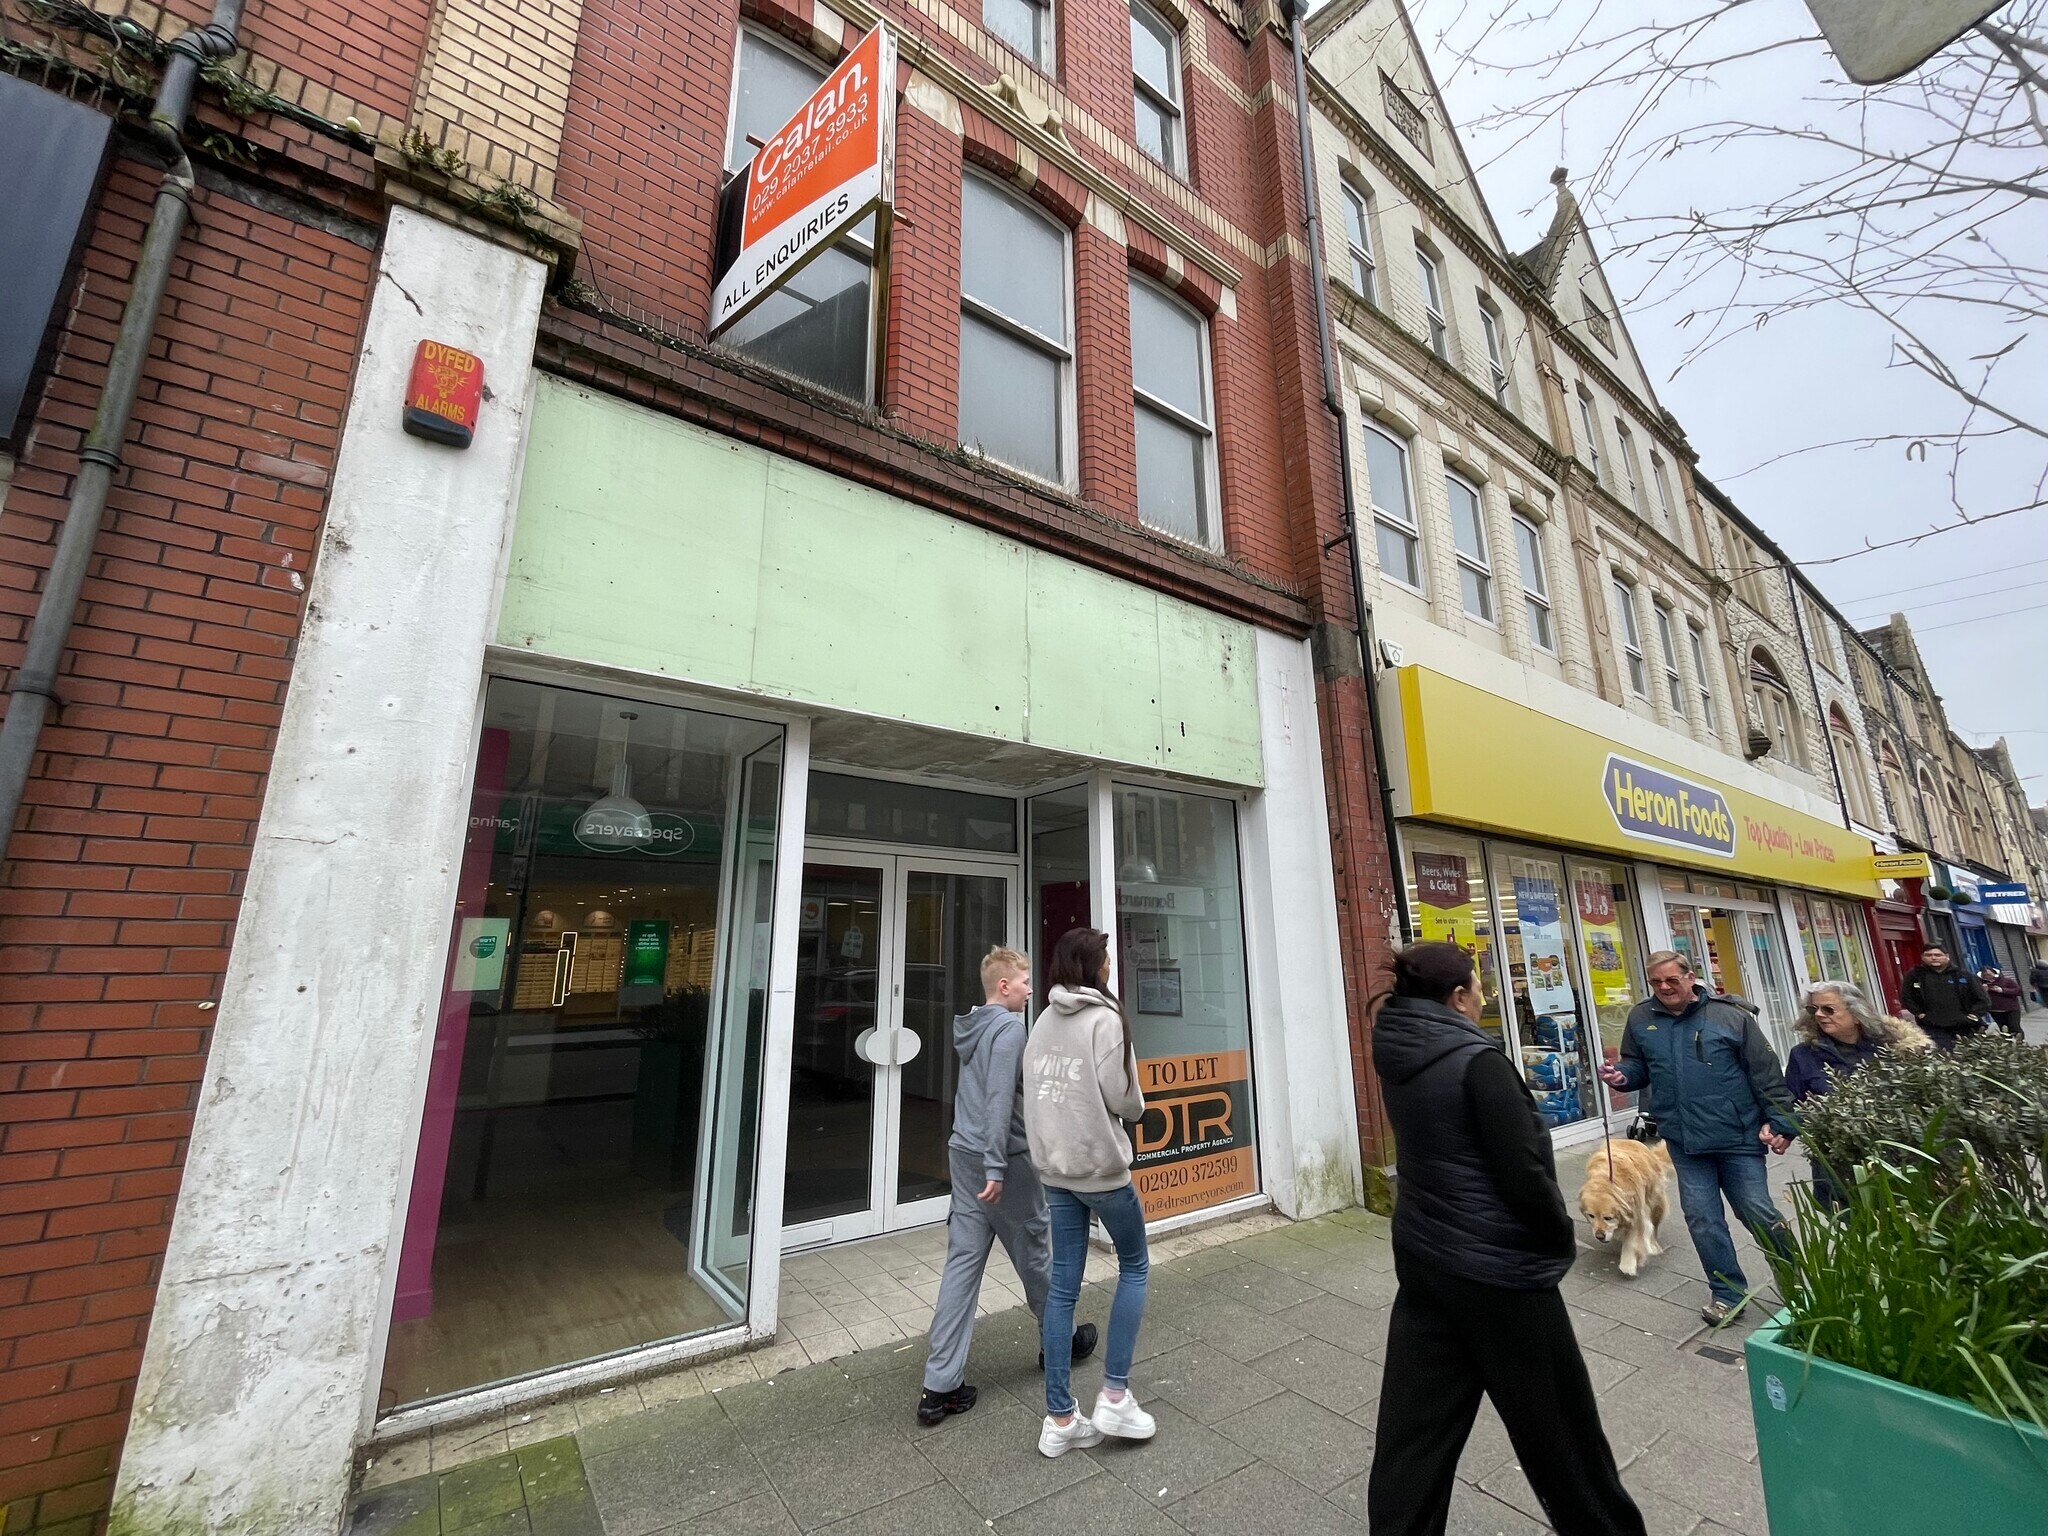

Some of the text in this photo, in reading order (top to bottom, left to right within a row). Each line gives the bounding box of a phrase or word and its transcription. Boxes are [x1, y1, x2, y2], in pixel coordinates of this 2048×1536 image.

[756, 62, 869, 184] Calan.
[751, 113, 868, 223] www.calanretail.co.uk
[752, 93, 869, 212] 029 2037 3933
[721, 193, 850, 315] ALL ENQUIRIES
[424, 341, 477, 373] DYFED
[415, 394, 466, 421] ALARMS
[1613, 768, 1730, 843] Heron Foods
[1743, 815, 1762, 850] Top
[1762, 821, 1793, 859] Quality
[1798, 832, 1814, 857] Low
[1813, 838, 1835, 864] Prices
[1421, 865, 1461, 878] Beers, Wines
[1430, 880, 1457, 892] & Ciders
[1584, 892, 1592, 914] 3
[1148, 1057, 1219, 1086] TO LET
[1135, 1091, 1233, 1153] DTR
[1136, 1136, 1234, 1162] COMMERCIAL PROPERTY AGENCY
[1140, 1155, 1238, 1194] 02920 372599
[1144, 1180, 1244, 1214] fo@dtrsurveyors.com
